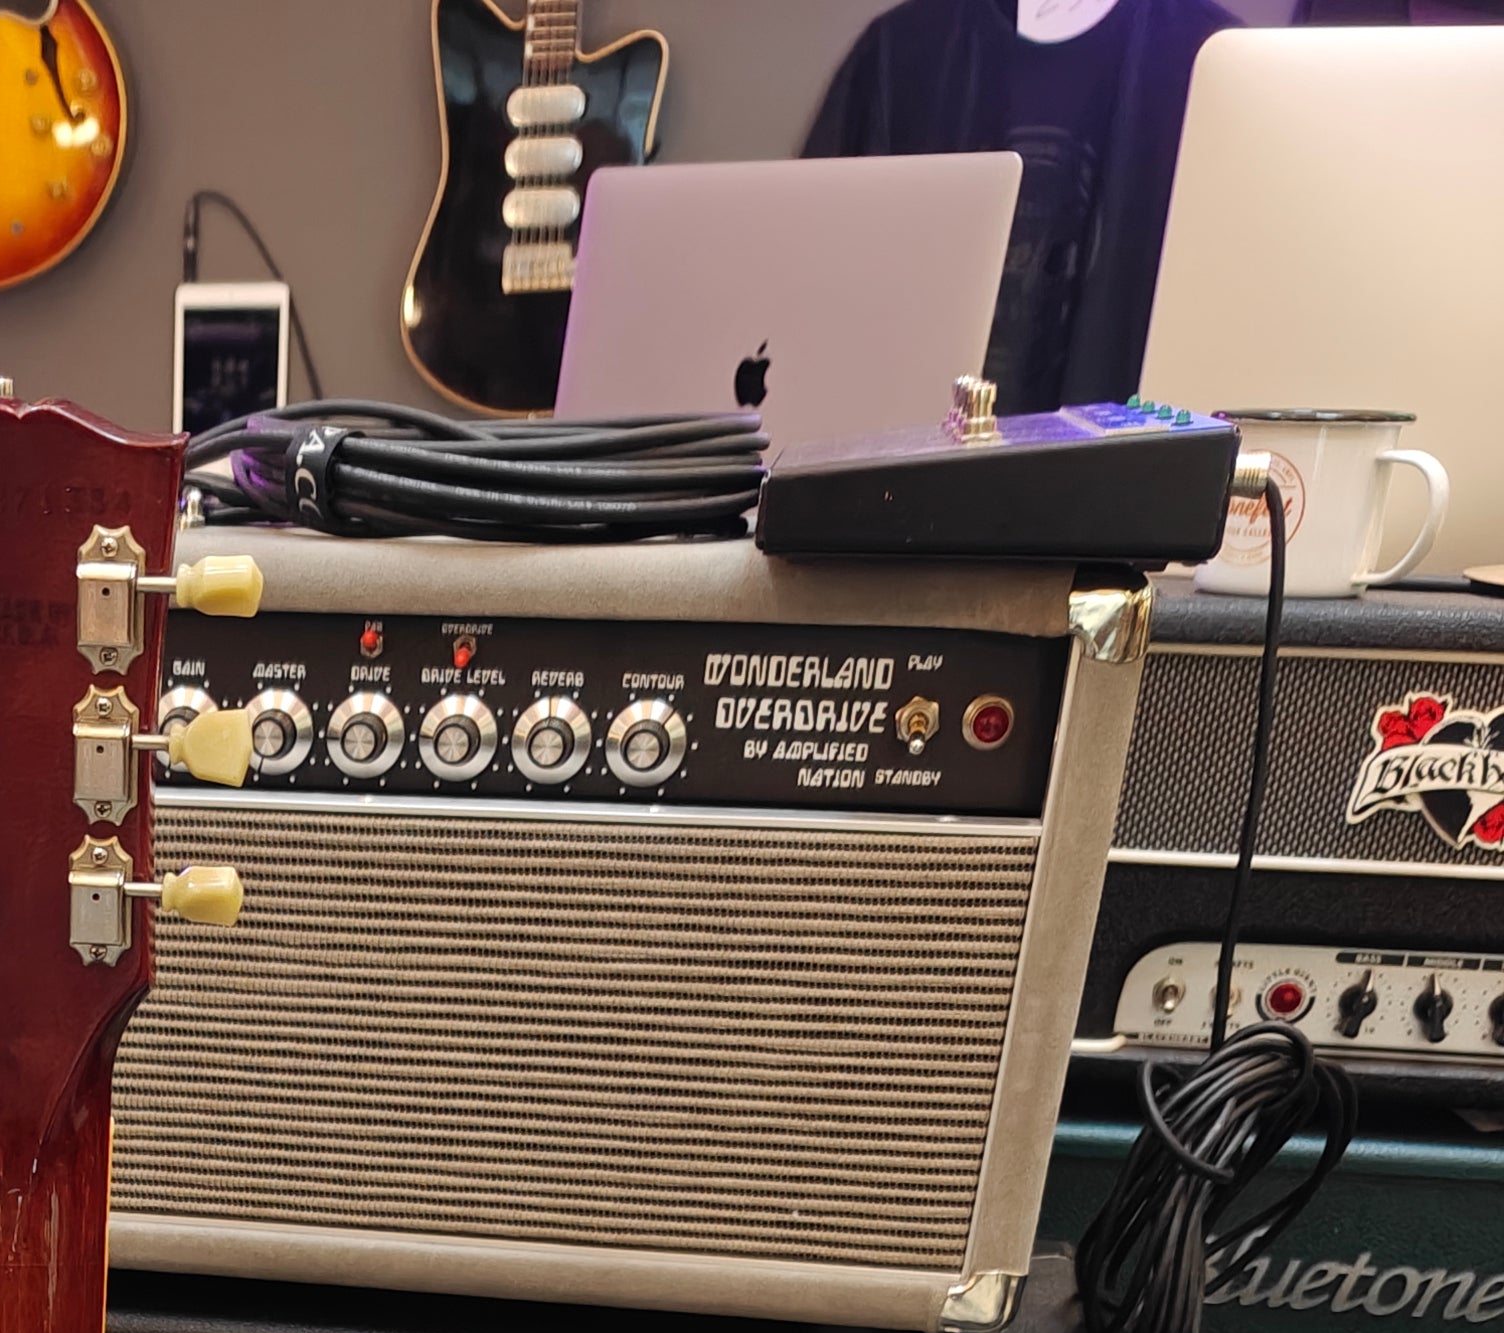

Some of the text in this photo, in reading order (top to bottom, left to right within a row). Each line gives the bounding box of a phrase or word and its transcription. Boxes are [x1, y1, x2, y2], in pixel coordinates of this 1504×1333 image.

[442, 623, 494, 636] OVERDRIVE
[172, 660, 206, 677] GAIN
[252, 662, 307, 680] MASTER
[704, 653, 894, 690] WONDERLAND
[907, 654, 943, 671] PLAY
[350, 664, 391, 682] DRIVE
[421, 667, 507, 686] DRIVE LEVEL
[531, 670, 585, 688] REVERB
[622, 672, 685, 691] CONTOUR
[715, 697, 889, 733] OVERDRIVE
[743, 739, 869, 762] BY AMPLIFIED
[797, 766, 866, 788] NATION
[874, 767, 942, 787] STANDBY
[1203, 1225, 1504, 1324] luetone
